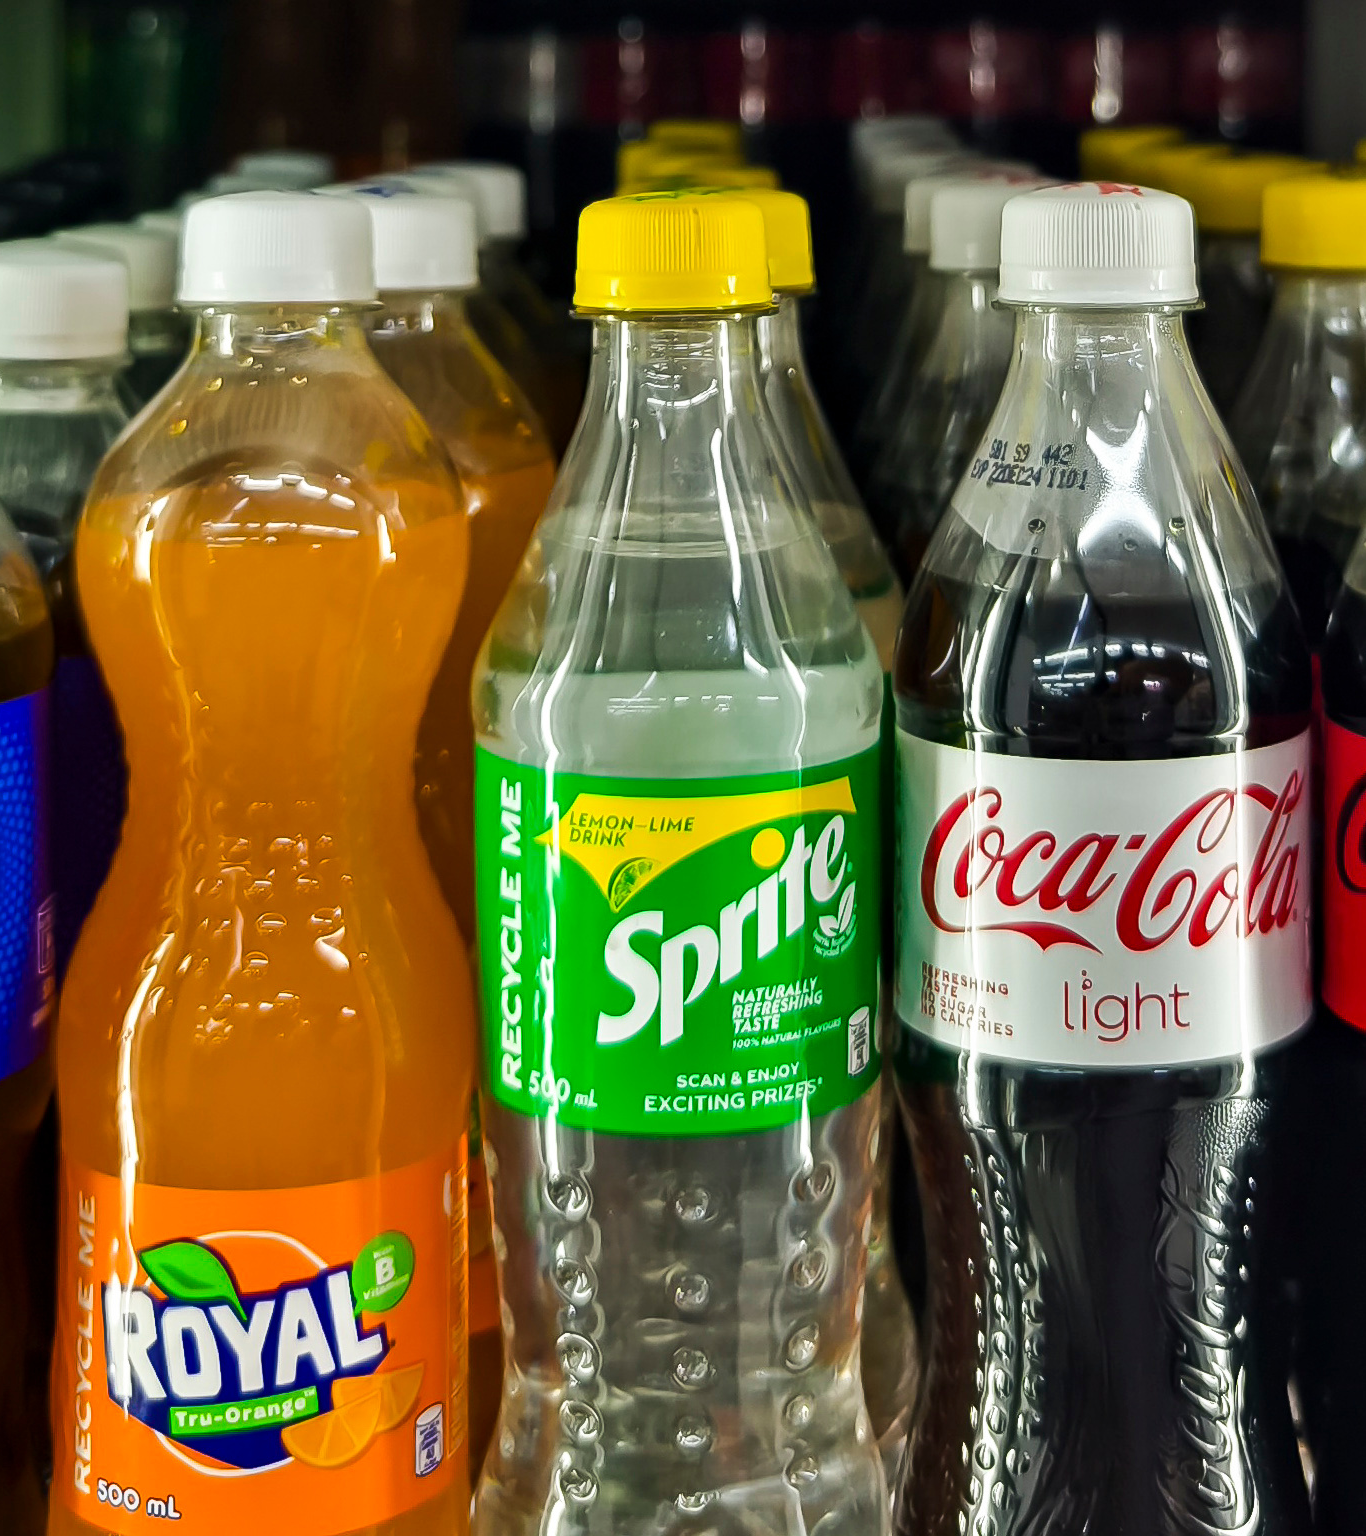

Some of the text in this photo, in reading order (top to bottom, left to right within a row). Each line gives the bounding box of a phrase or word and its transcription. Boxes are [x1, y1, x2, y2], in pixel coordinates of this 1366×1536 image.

[569, 828, 627, 847] DRINK
[920, 770, 1304, 956] Coca-Cola
[501, 776, 522, 1090] RECYCLE ME
[596, 814, 847, 1047] Sprite
[732, 976, 818, 1004] NATURALLY
[733, 990, 822, 1018] REFRESHING
[939, 996, 987, 1019] SUGAR
[1064, 970, 1191, 1044] light
[733, 1014, 780, 1035] TASTE
[941, 1009, 1014, 1036] CALORIES
[761, 1028, 801, 1046] NATURAL
[676, 1061, 800, 1089] SCAN ENJOY
[644, 1090, 745, 1113] EXCITING
[376, 1256, 395, 1285] B
[75, 1191, 96, 1494] RECYCLE ME
[105, 1270, 383, 1400] ROYAL
[175, 1397, 307, 1428] Tru-Orange
[97, 1479, 181, 1520] 500 mL
